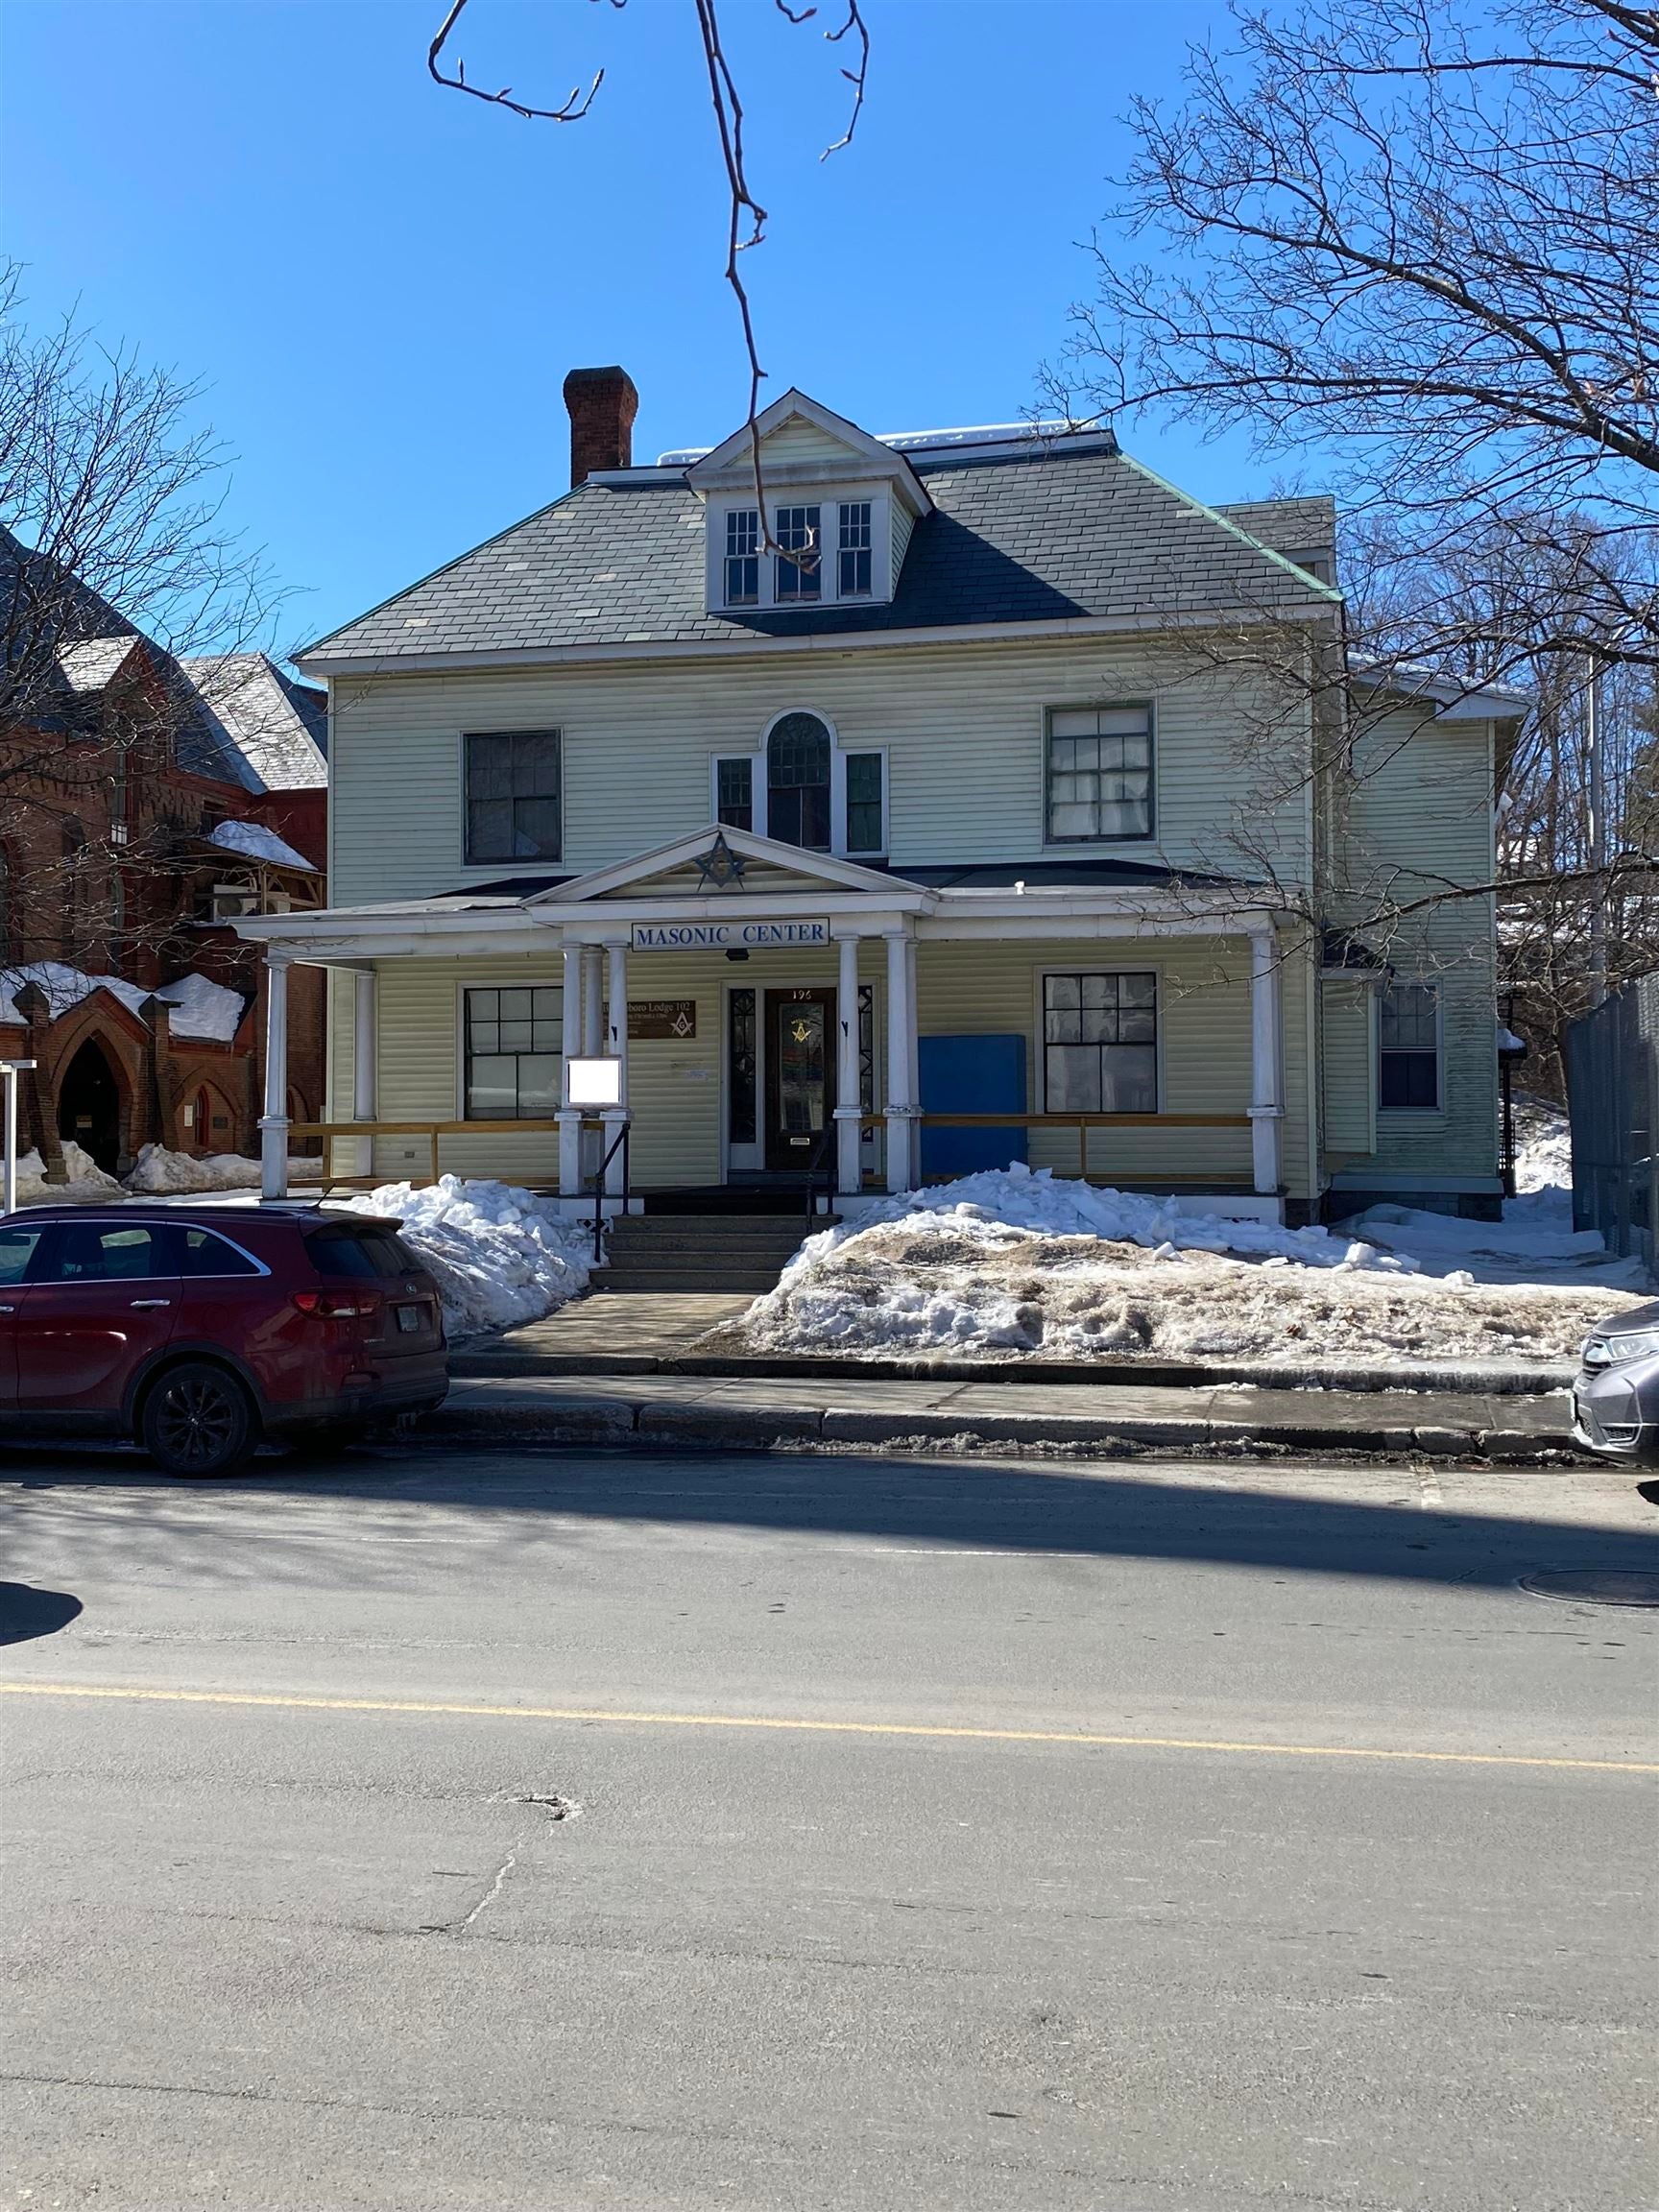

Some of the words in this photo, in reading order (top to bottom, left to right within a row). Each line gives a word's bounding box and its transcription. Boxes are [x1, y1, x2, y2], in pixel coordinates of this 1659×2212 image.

[637, 926, 730, 946] MASONIC
[743, 924, 825, 943] CENTER
[793, 990, 812, 999] 196
[648, 1002, 674, 1013] Lodge
[676, 1001, 690, 1011] 102
